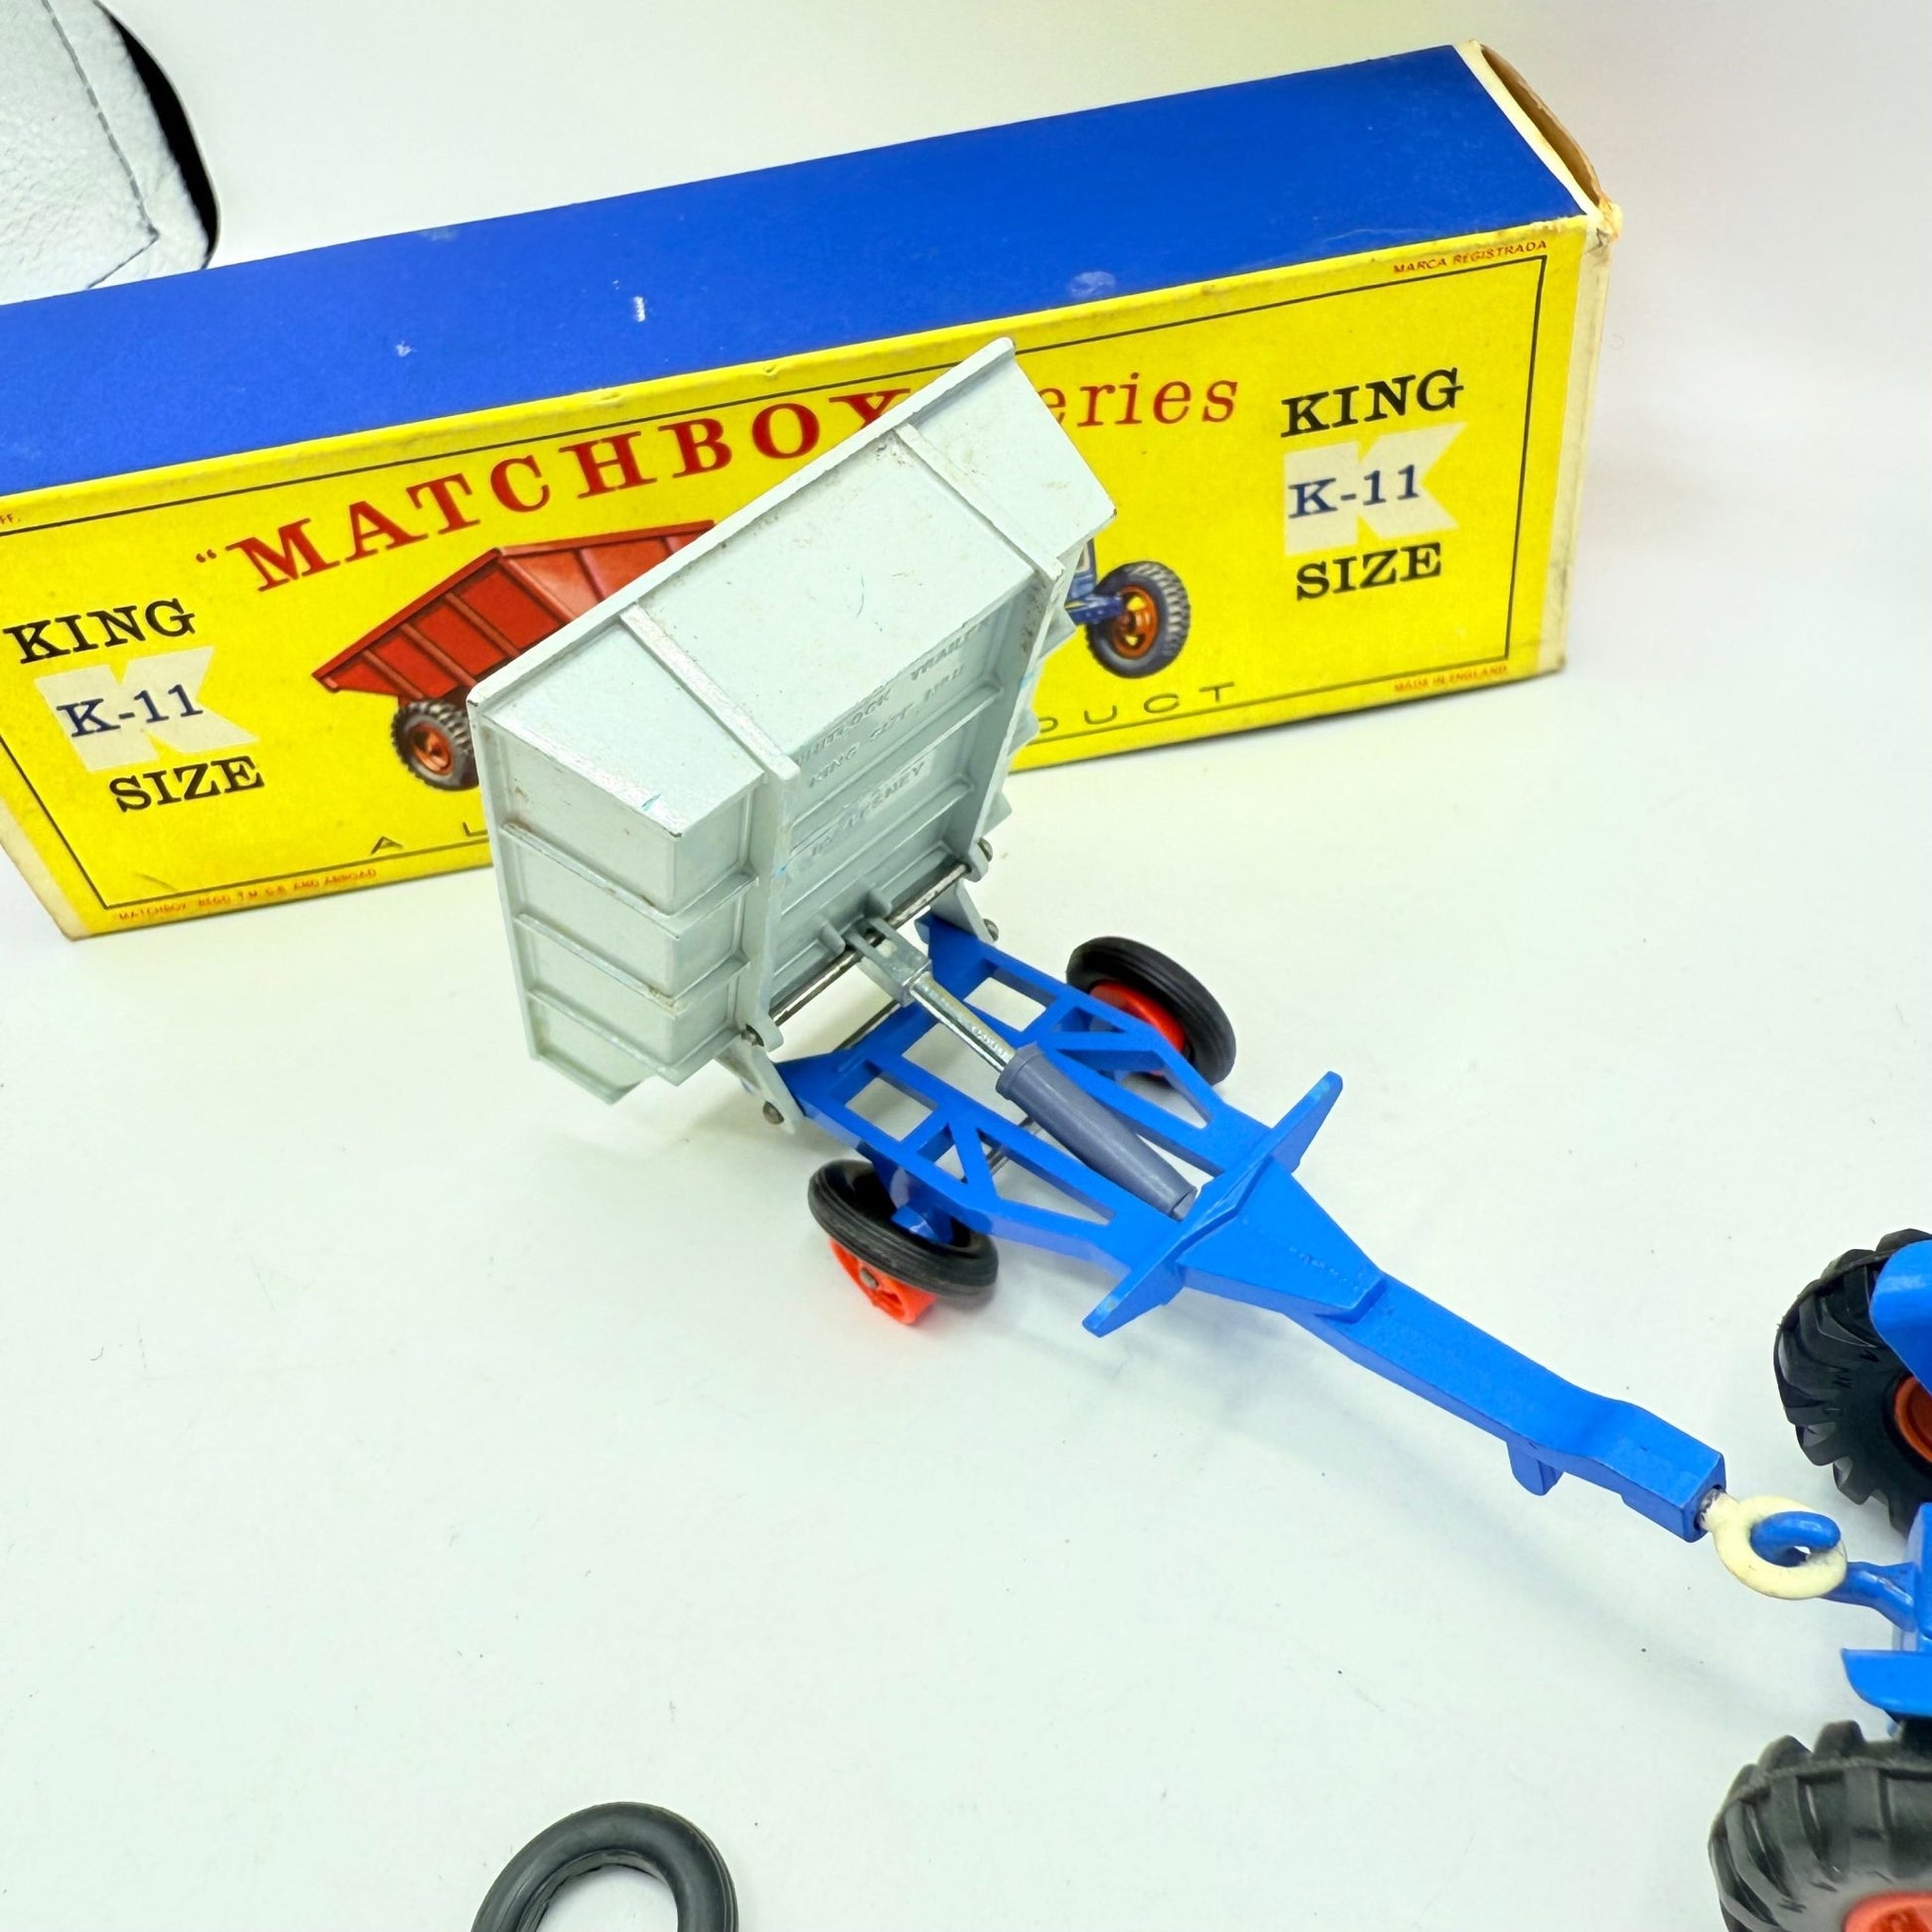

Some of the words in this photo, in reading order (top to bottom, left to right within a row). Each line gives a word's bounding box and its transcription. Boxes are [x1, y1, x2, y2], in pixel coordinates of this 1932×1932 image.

[1393, 257, 1447, 274] MARCA
[1452, 239, 1548, 265] REGISTRADA
[1037, 371, 1238, 427] eries
[1281, 367, 1465, 438] KING
[1289, 464, 1420, 518] K-11
[1297, 542, 1443, 601] SIZE
[2, 598, 197, 664] KING
[56, 684, 205, 738] K-11
[109, 756, 265, 812] SIZE
[369, 835, 405, 855] A
